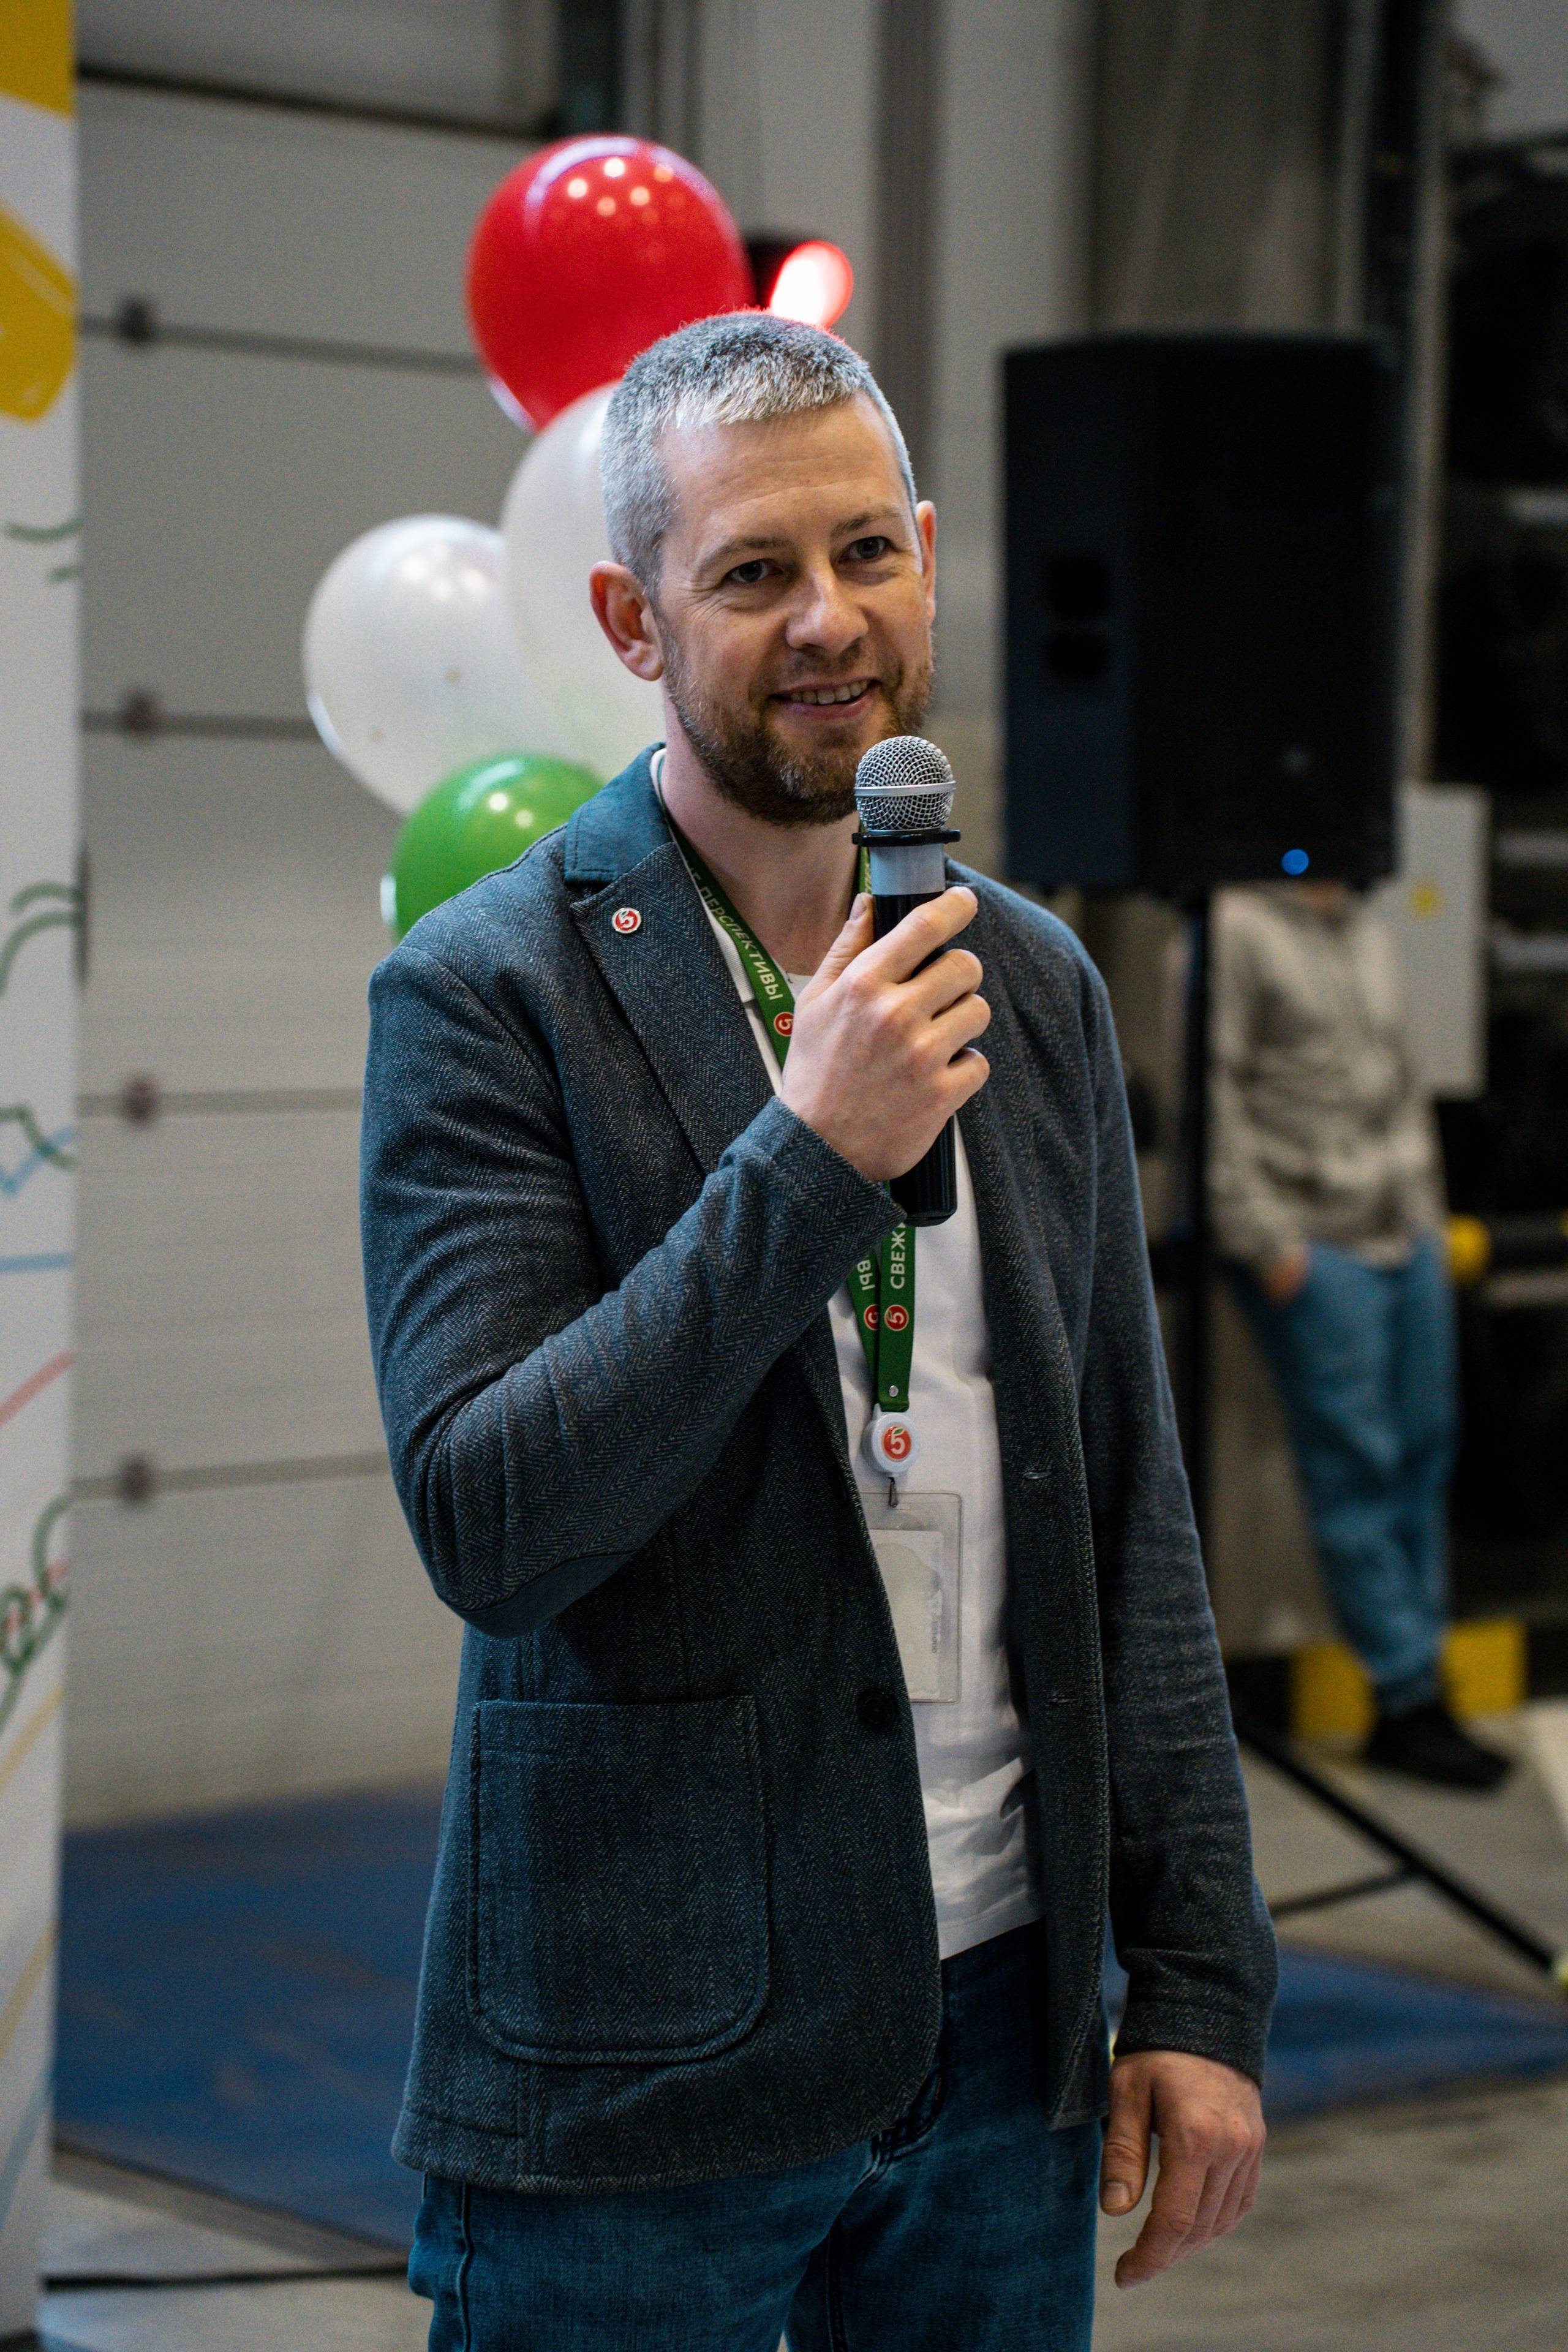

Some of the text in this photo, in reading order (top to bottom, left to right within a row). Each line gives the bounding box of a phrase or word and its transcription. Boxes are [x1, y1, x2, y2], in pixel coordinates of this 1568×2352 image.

[618, 910, 635, 929] 5
[699, 886, 783, 1000] ПЕРСПЕКТИВЫ
[888, 1308, 905, 1325] 5
[890, 1427, 906, 1455] 5
